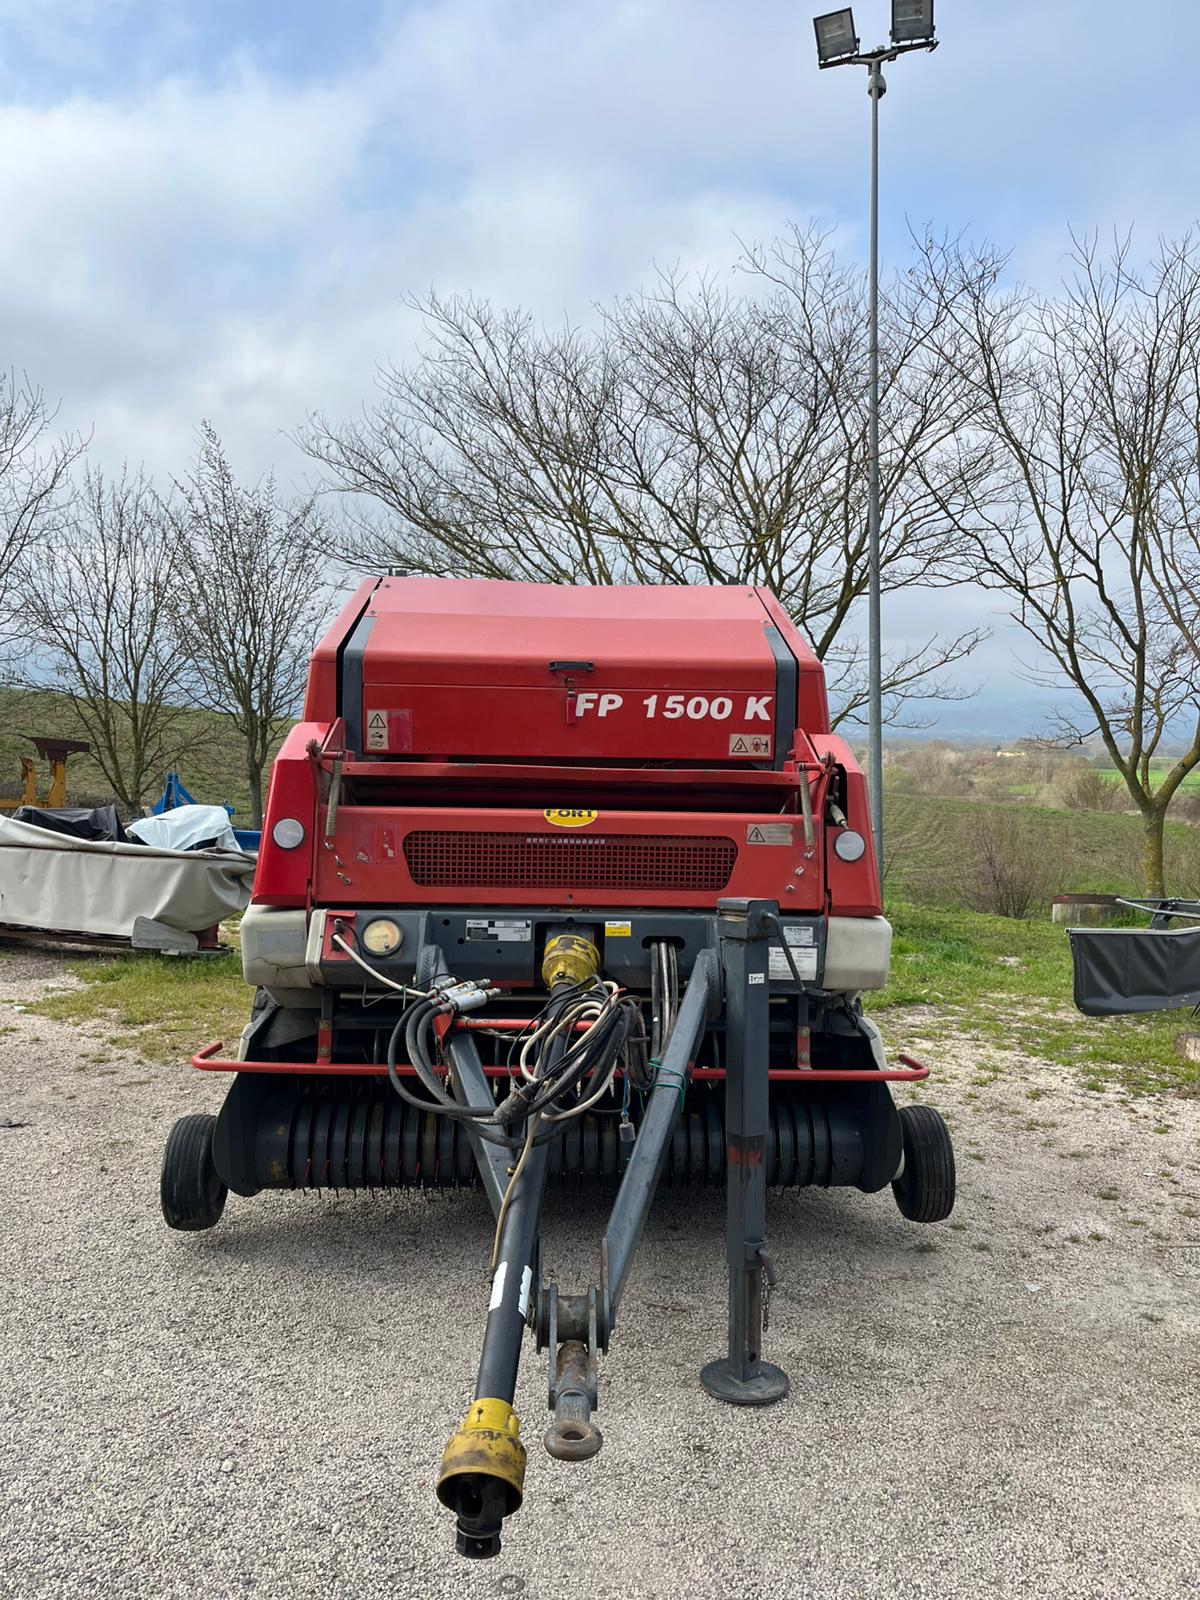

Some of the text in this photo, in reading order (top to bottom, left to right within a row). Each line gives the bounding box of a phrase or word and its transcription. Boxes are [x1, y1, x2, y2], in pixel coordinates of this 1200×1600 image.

[575, 693, 773, 720] FP 1500 K
